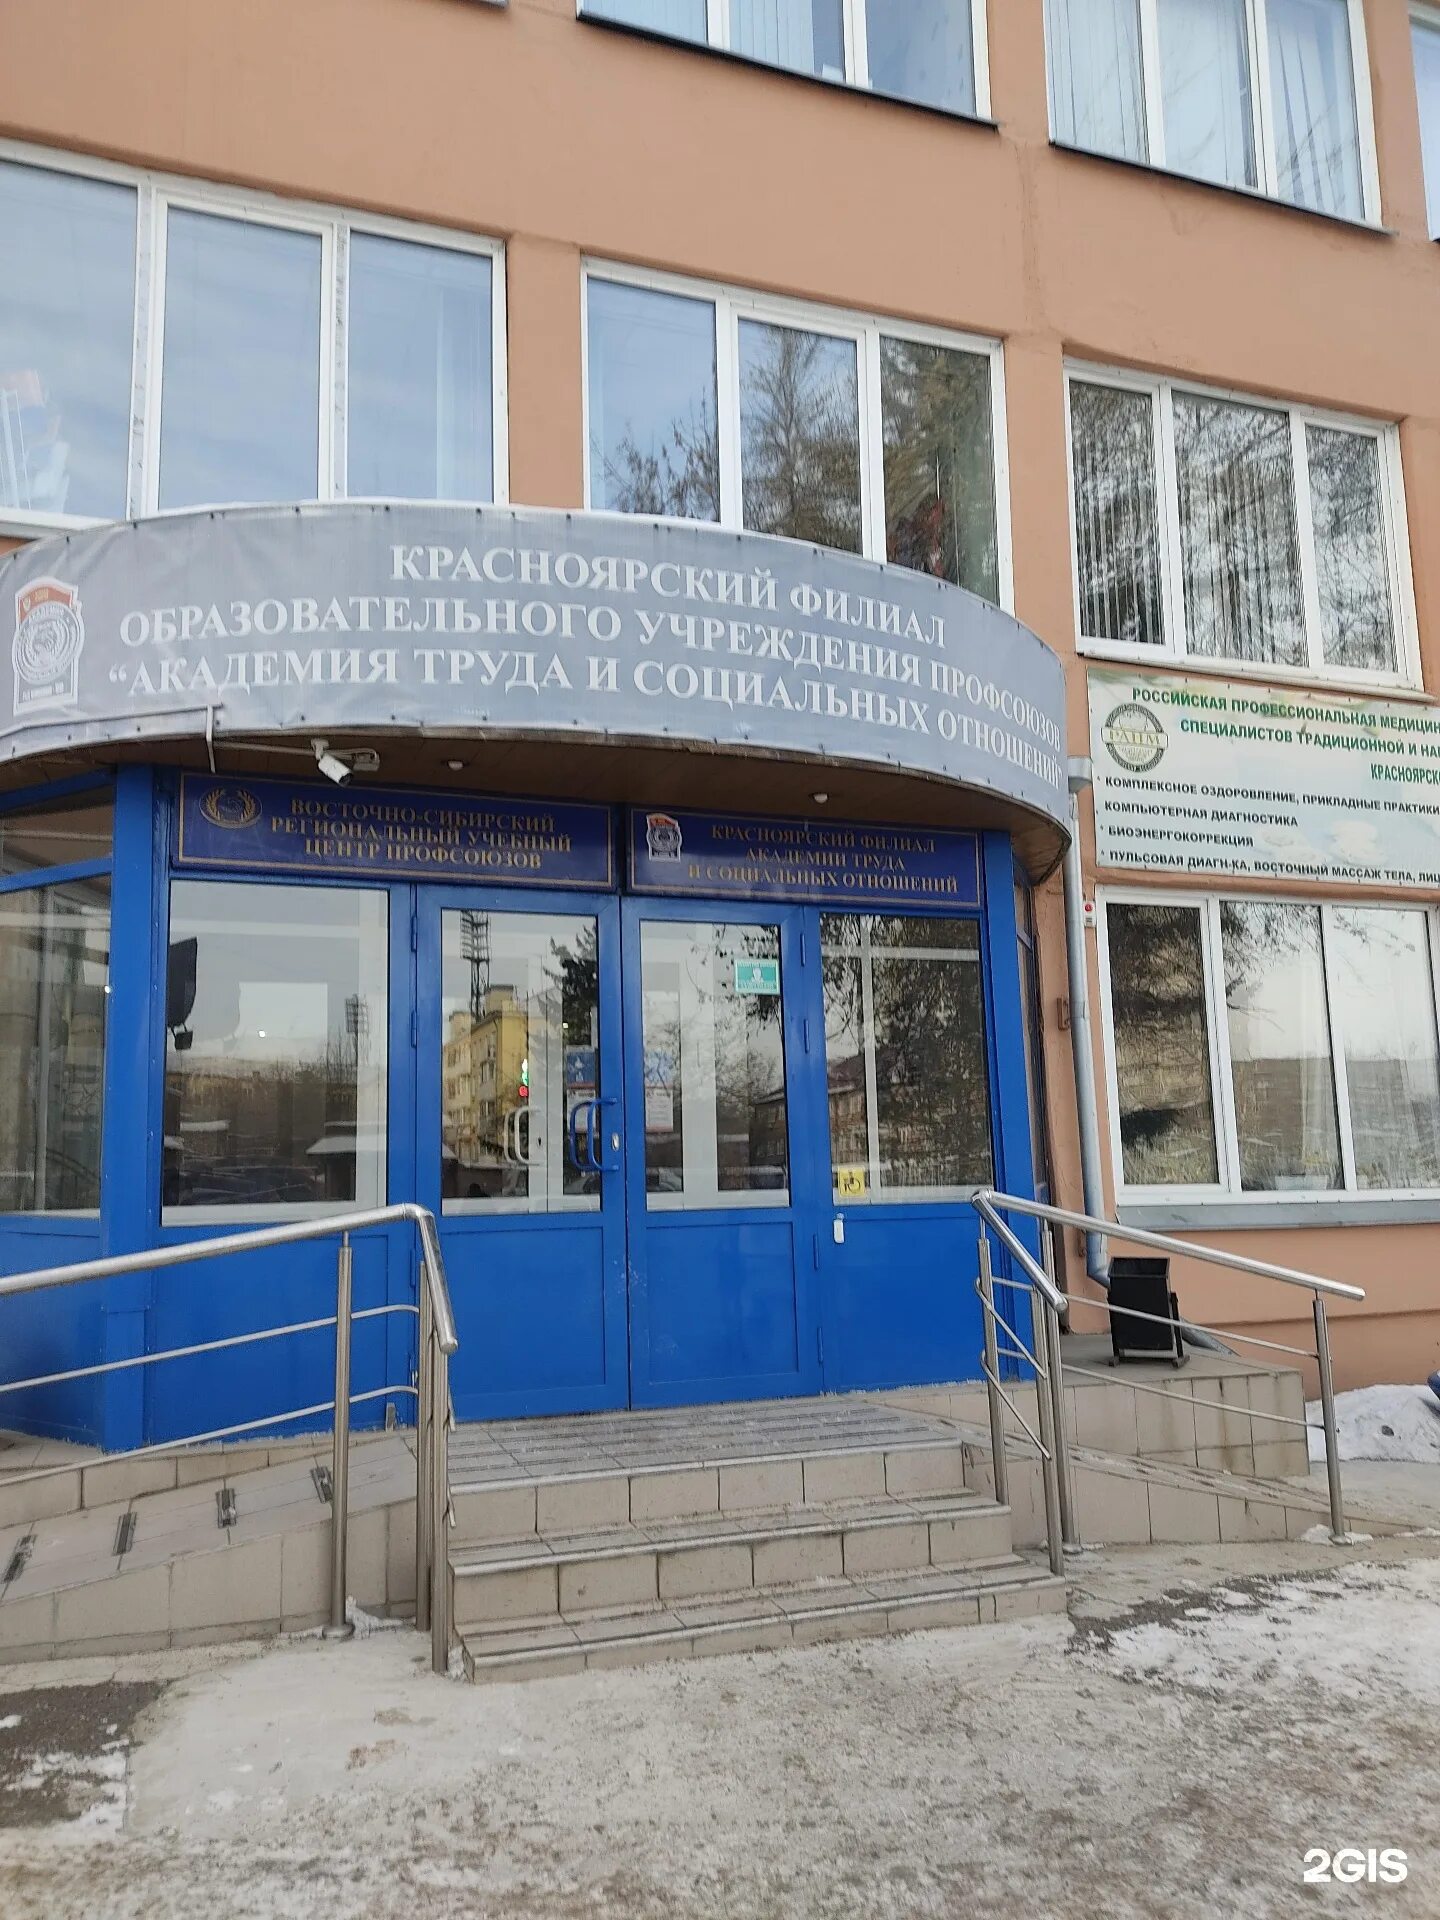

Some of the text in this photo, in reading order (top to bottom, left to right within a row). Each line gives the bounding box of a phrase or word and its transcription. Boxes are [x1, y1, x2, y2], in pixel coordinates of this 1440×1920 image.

[389, 544, 947, 650] КРАСНОЯРСКИЙ ФИЛИАЛ
[119, 596, 1061, 753] ОБРАЗОВАТЕЛЬНОГО УЧРЕЖДЕНИЯ ПРОФСОЮЗОВ
[413, 649, 574, 696] ТРУДА
[586, 656, 621, 692] И
[633, 660, 930, 735] СОЦИАЛЬНЫХ
[1132, 687, 1227, 711] РОССИЙСКАЯ
[1231, 699, 1377, 728] ПРОФЕССИОНАЛЬНАЯ
[1180, 719, 1440, 759] СПЕЦИАЛИСТОВ ТРАДИЦИОННОЙ И НА
[1371, 763, 1440, 786] КРАСНОЯРСК
[1105, 776, 1440, 815] КОМПЛЕКСНОЕ ОЗДОРОВЛЕНИЕ, ПРИКЛАДНЫЕ ПРАКТИКИ
[291, 799, 555, 833] ВОСТОЧНО-СИБИРСКИЙ
[1104, 801, 1299, 827] КОМПЬЮТЕРНАЯ ДИАГНОСТИКА
[271, 816, 571, 852] РЕГИОНАЛЬНЫЙ УЧЕБНЫЙ
[712, 824, 935, 853] КРАСНОЯРСКИЙ ФИЛИАЛ
[1108, 825, 1254, 848] БИОЭНЕРГОКОРРЕКЦИЯ
[305, 839, 541, 869] ЦЕНТР ПРОФСОЮЗОВ
[746, 847, 906, 872] АКАДЕМИИ ТРУДА
[1110, 850, 1184, 867] ПУЛЬСОВАЯ
[1254, 861, 1329, 876] ВОСТОЧНЫЙ
[1332, 867, 1381, 879] МАССАЖ
[1384, 870, 1416, 883] ТЕЛА,
[688, 864, 958, 894] И СОЦИАЛЬНЫХ ОТНОШЕНИЙ
